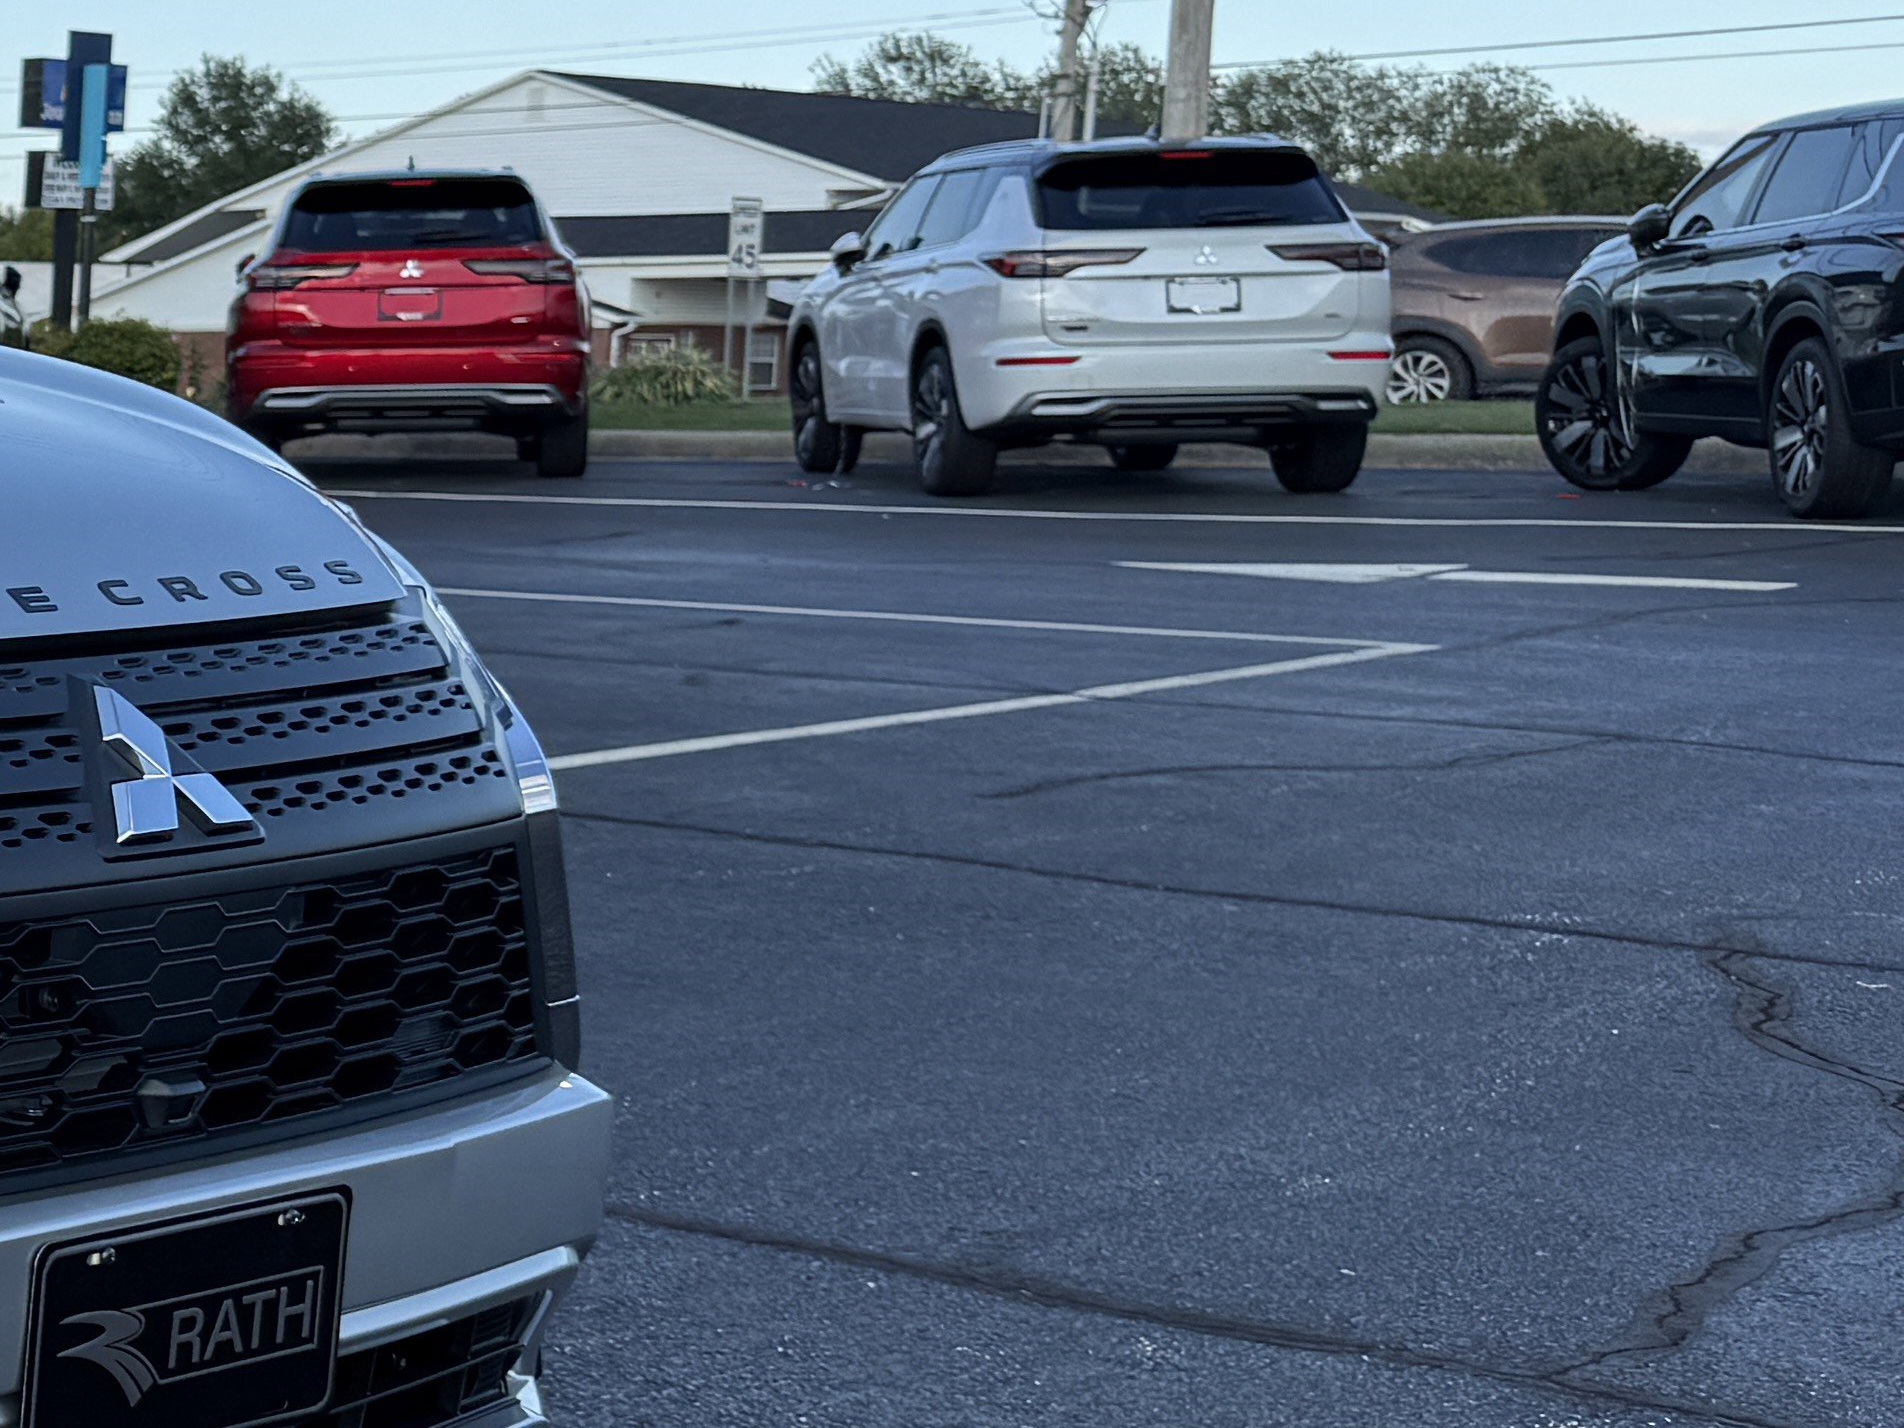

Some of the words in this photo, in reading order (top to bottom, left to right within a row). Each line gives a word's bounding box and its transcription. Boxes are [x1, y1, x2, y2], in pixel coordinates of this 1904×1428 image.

[731, 243, 756, 269] 45
[97, 560, 363, 606] CROSS
[167, 1278, 315, 1370] RATH
